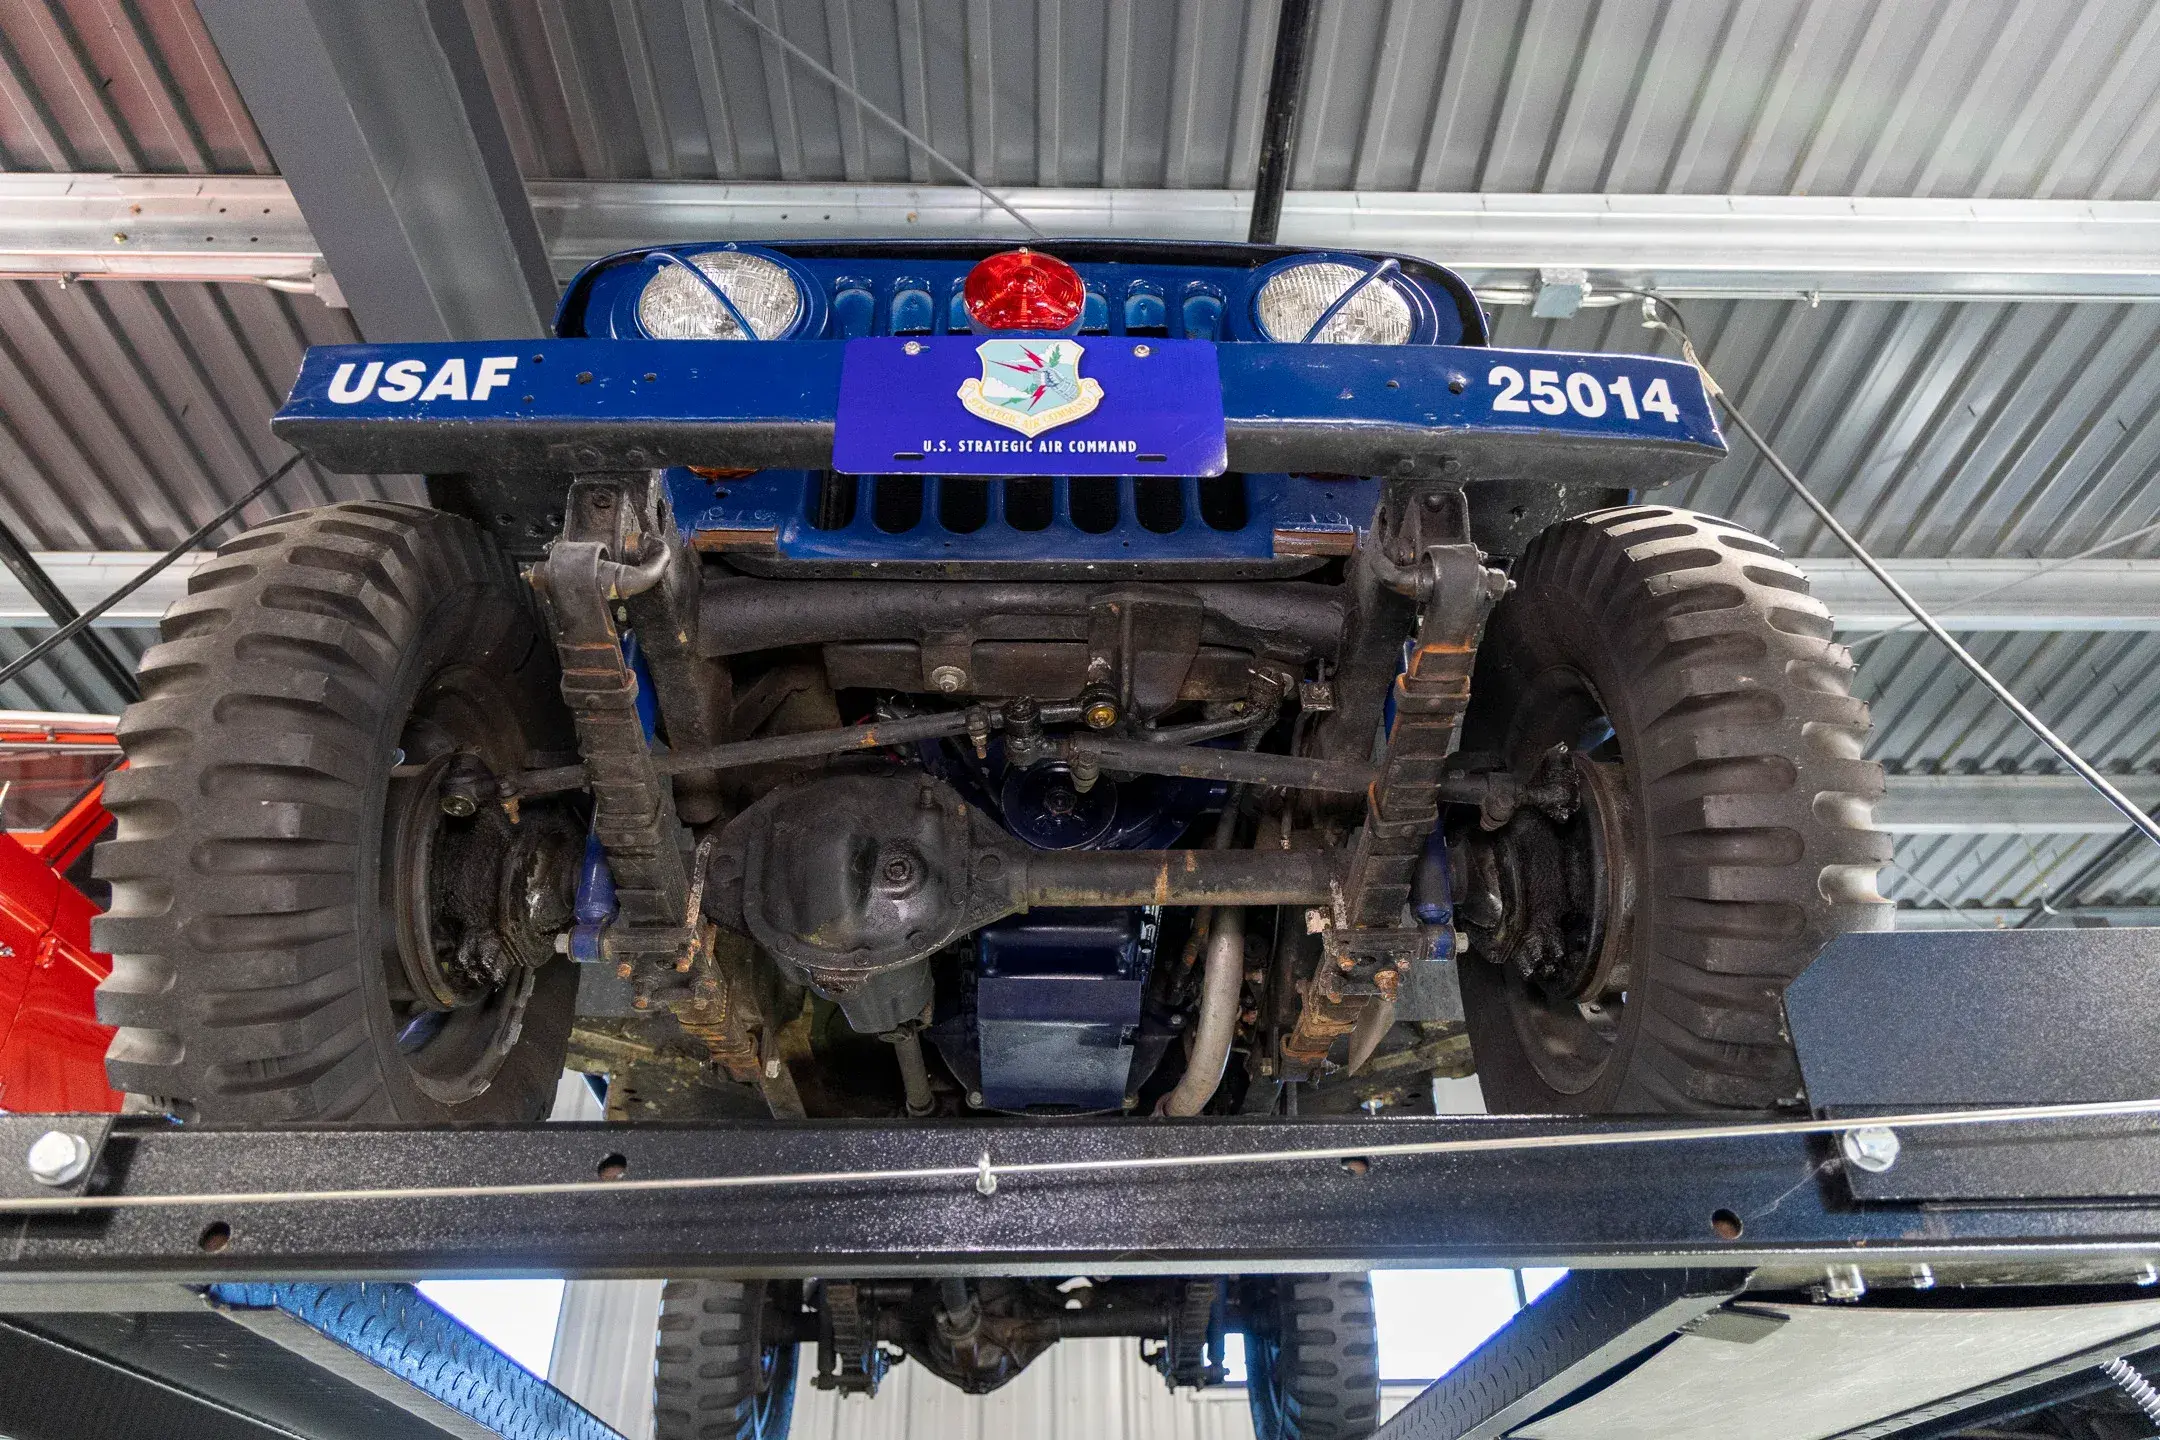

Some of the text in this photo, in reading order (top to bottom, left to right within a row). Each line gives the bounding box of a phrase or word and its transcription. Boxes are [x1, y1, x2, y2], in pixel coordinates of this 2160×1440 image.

[327, 356, 518, 404] USAF
[1488, 365, 1680, 423] 25014
[923, 440, 1137, 453] U.S. STRATEGIC AIR COMMAND
